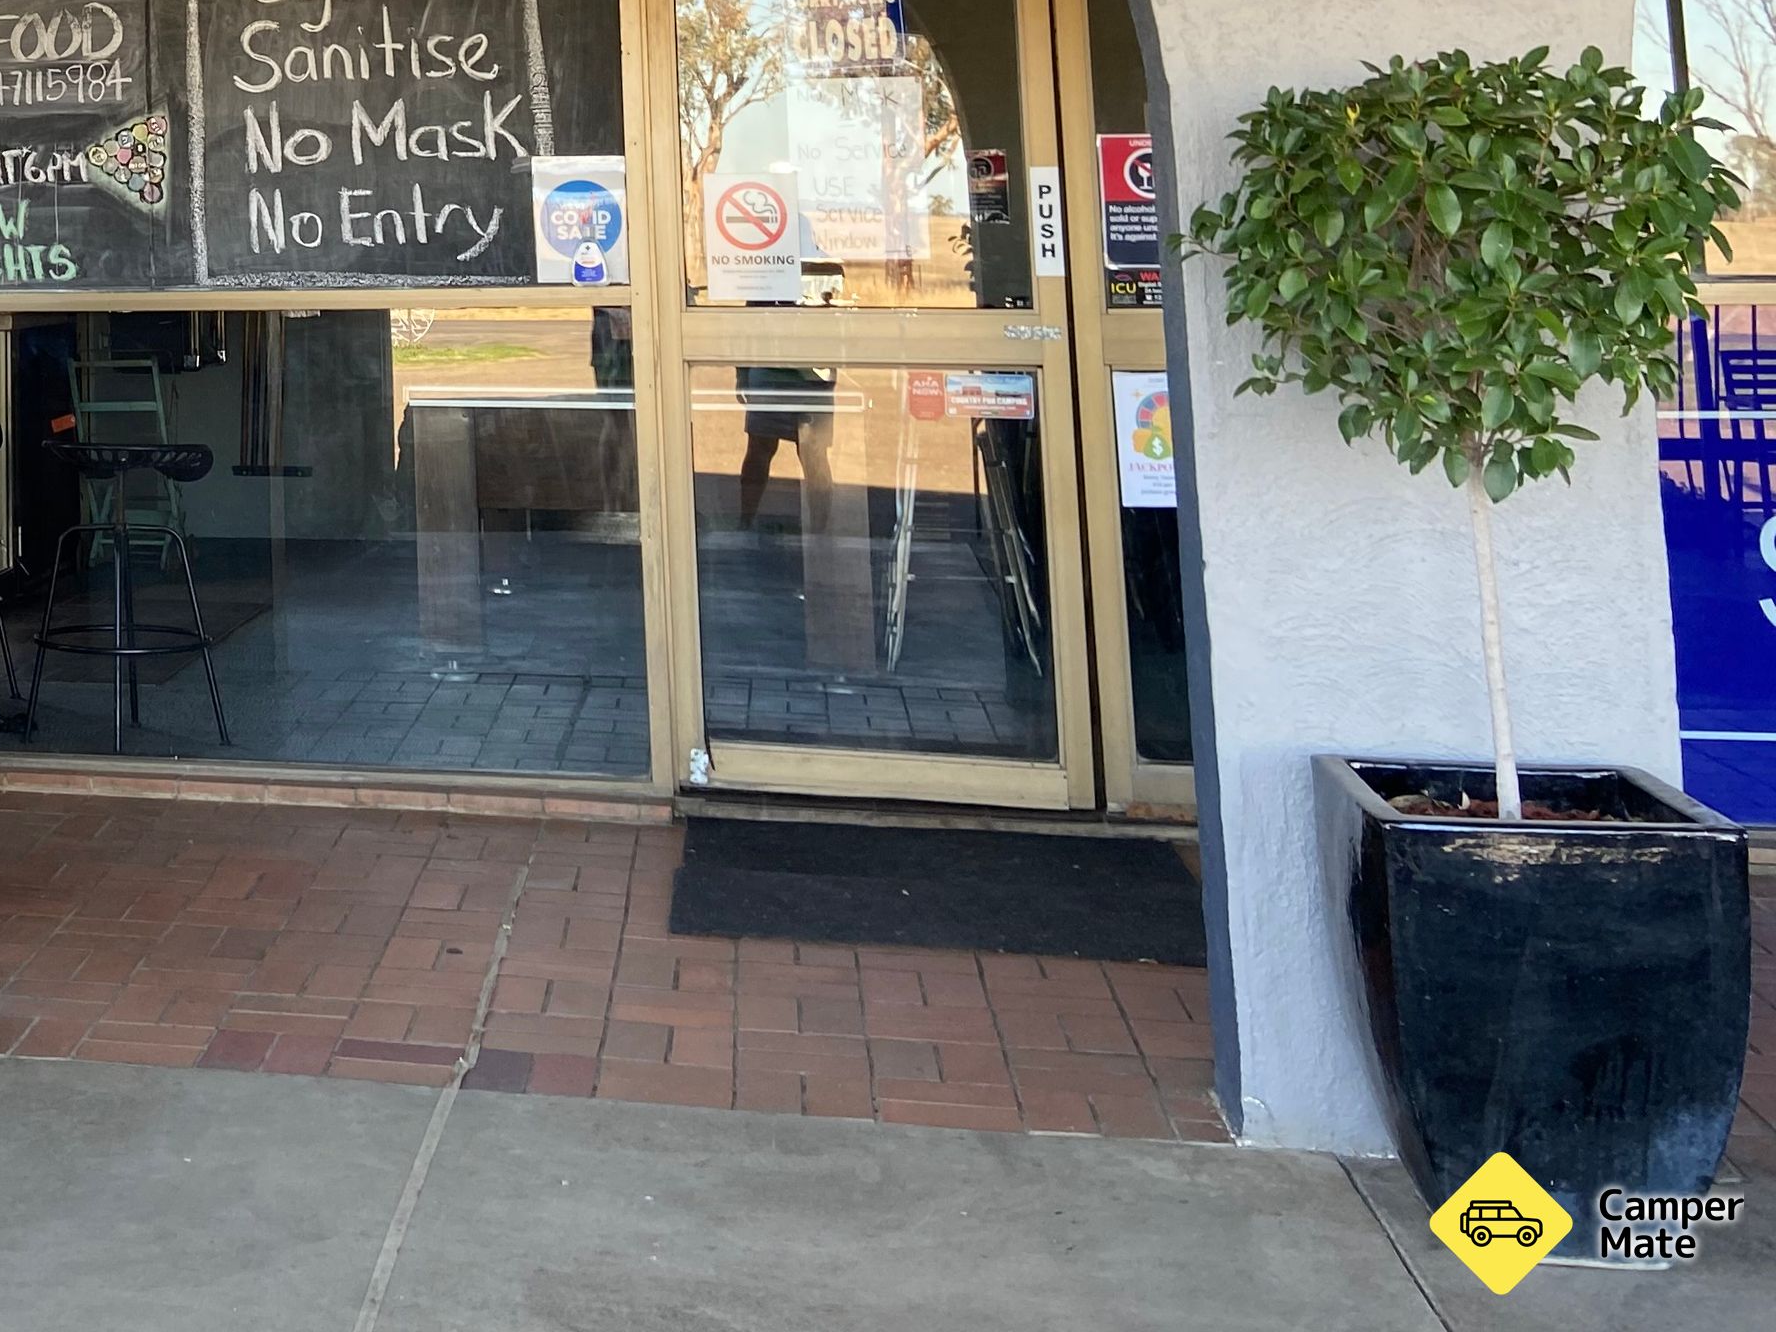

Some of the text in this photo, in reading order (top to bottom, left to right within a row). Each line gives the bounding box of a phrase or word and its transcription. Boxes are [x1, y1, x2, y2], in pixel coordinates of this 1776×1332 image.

[234, 4, 500, 93] Sanitise
[244, 101, 333, 174] No
[248, 183, 503, 262] No Entry
[1037, 184, 1056, 258] PUSH
[1109, 205, 1122, 213] No
[711, 255, 795, 266] NO SMOKING
[1111, 282, 1137, 294] ICU
